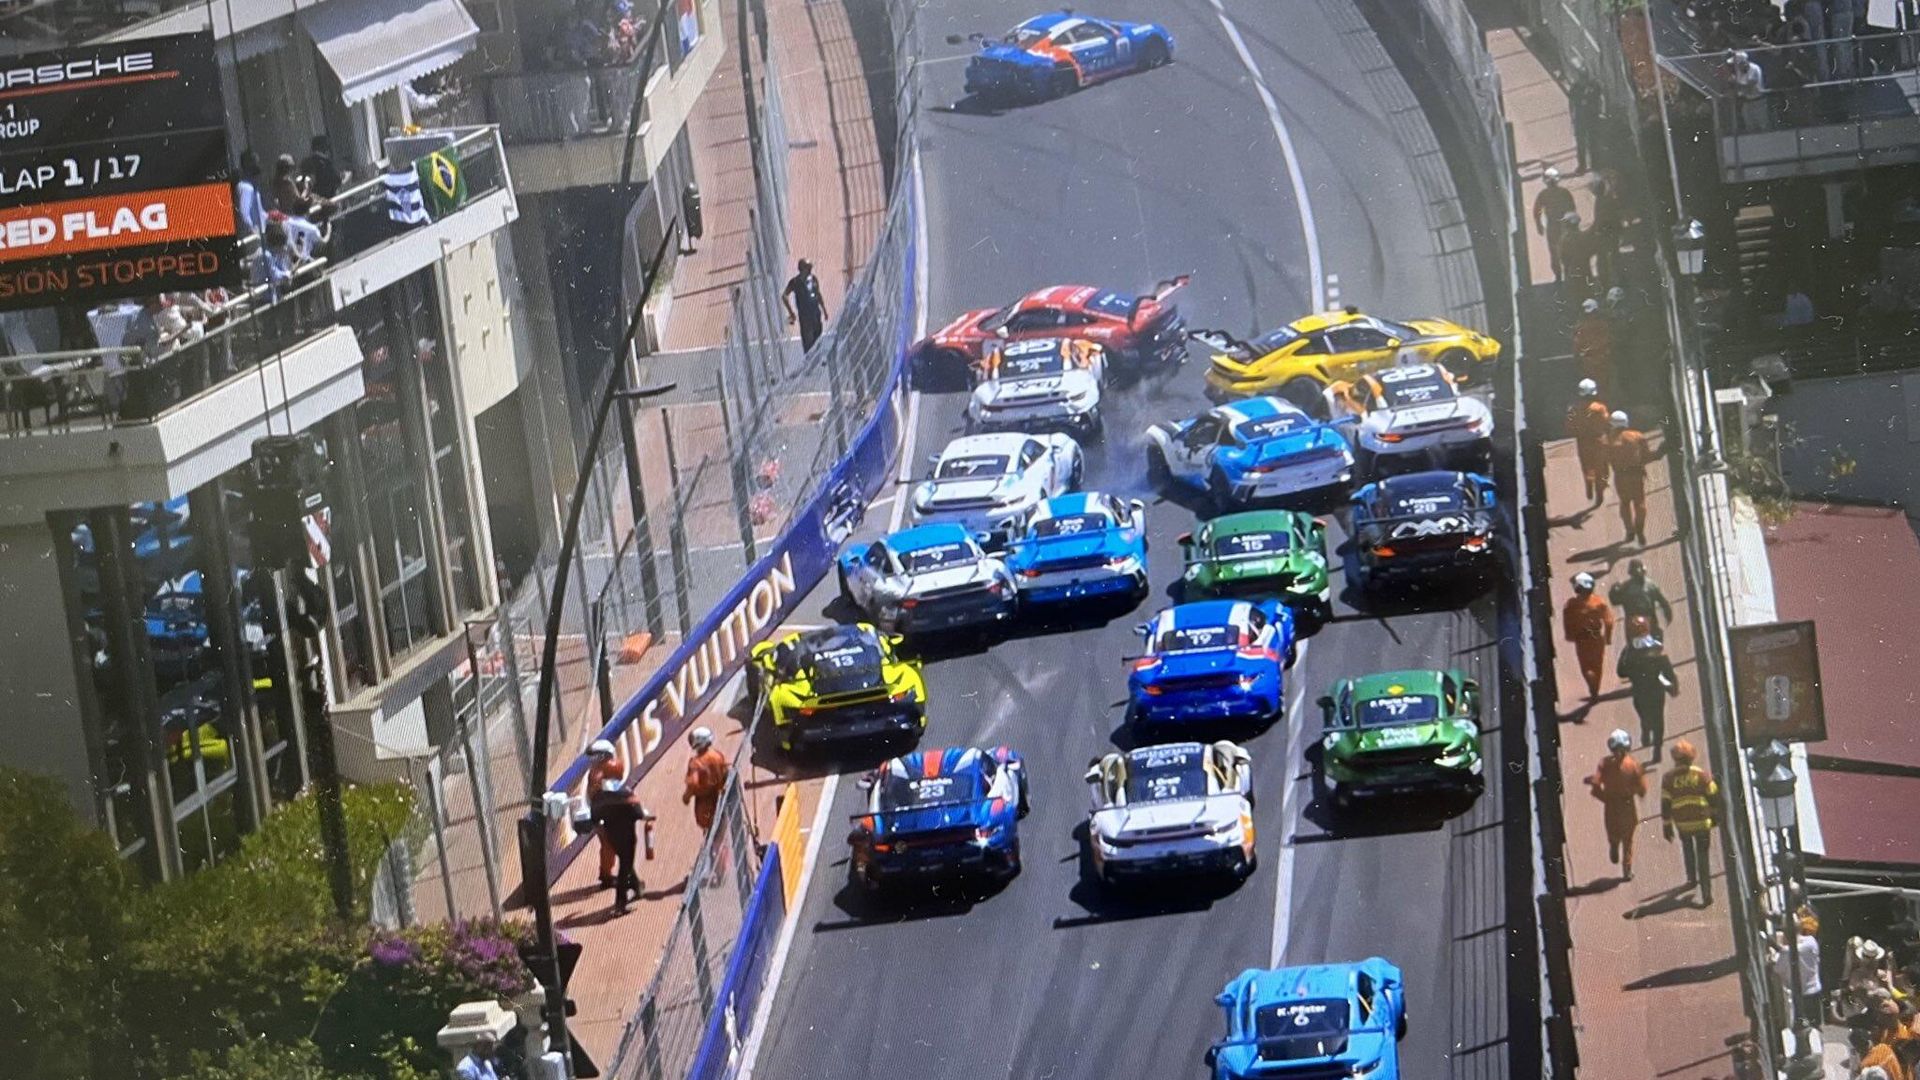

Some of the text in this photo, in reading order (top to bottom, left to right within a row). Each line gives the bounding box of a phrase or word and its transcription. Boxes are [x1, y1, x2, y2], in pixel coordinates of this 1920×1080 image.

[0, 52, 153, 89] RSCHE
[7, 103, 14, 118] 1
[0, 166, 55, 193] LAP
[0, 203, 168, 250] ED FLAG
[77, 251, 219, 288] STOPPED
[665, 551, 796, 718] VUITTON
[1190, 634, 1212, 646] 19
[831, 655, 854, 668] 13
[1386, 703, 1408, 715] 17
[919, 784, 945, 799] 23
[1154, 785, 1177, 799] 21
[1294, 1011, 1310, 1026] 6
